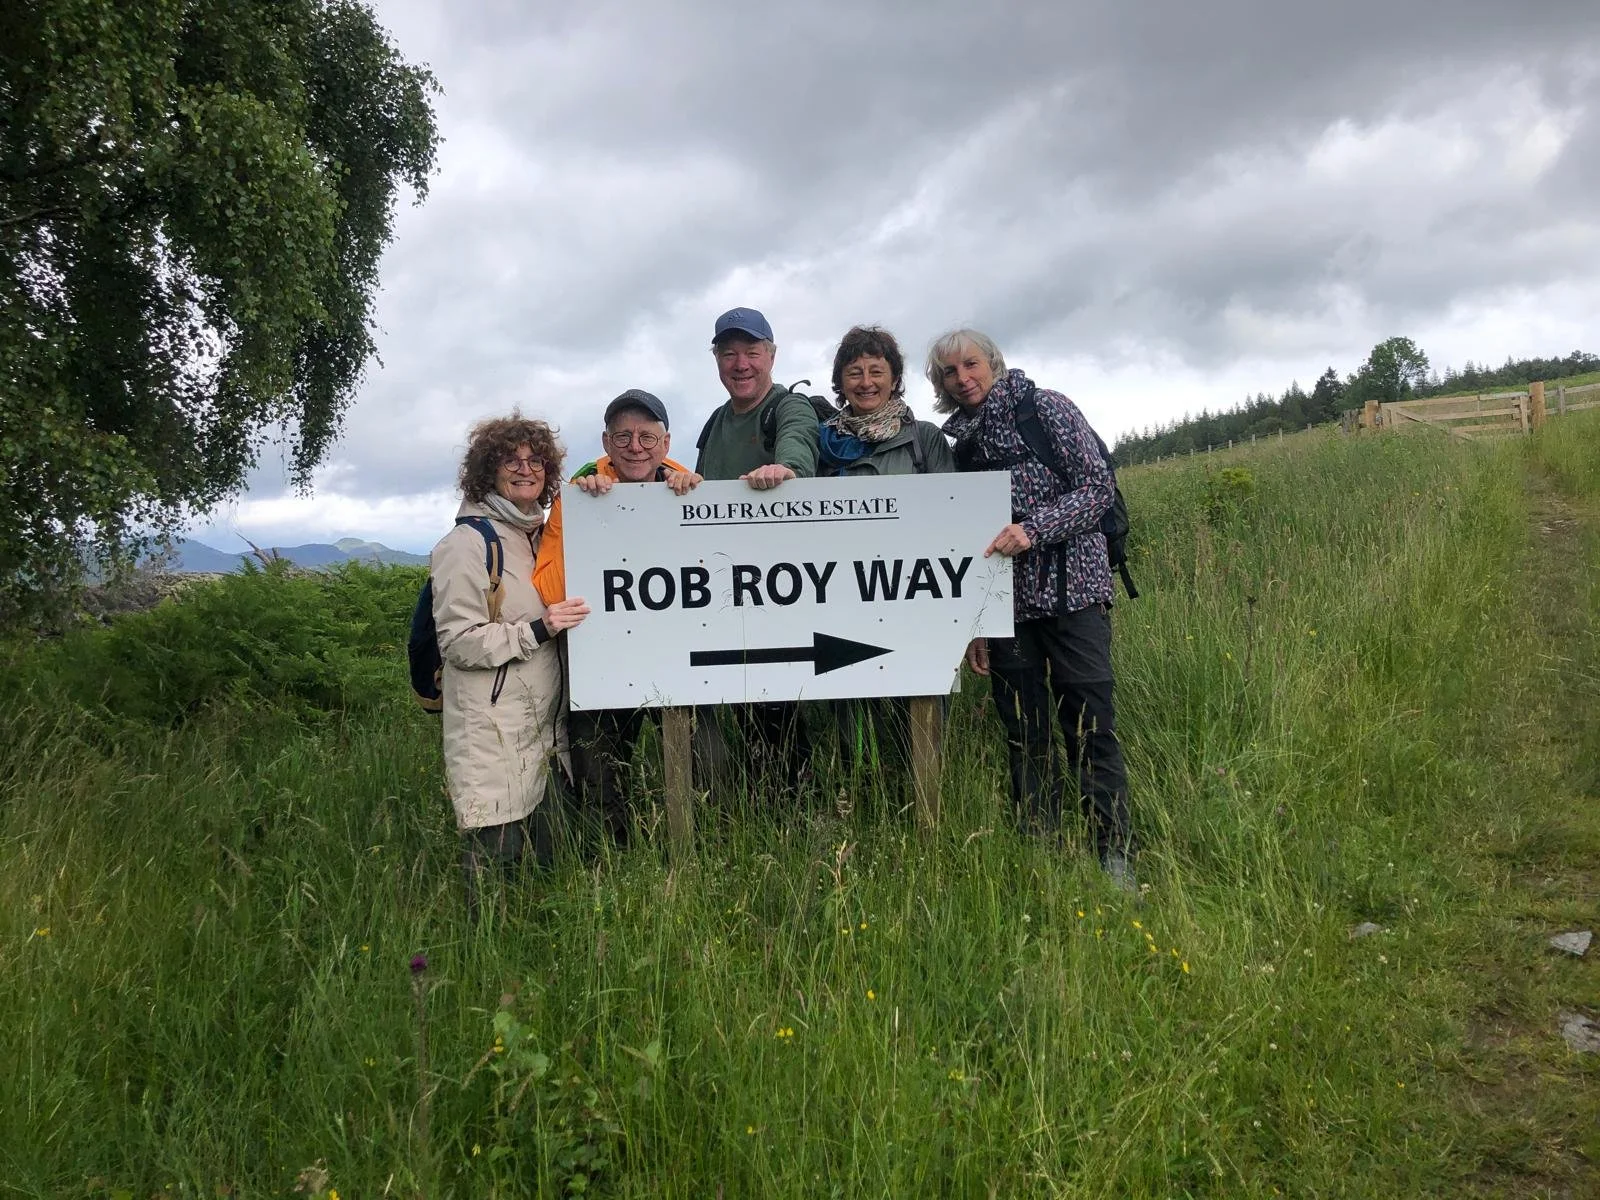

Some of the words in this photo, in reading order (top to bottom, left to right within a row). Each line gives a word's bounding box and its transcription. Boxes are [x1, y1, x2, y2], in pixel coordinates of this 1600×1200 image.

[681, 500, 813, 520] BOLFRACKS
[819, 497, 899, 517] ESTATE
[604, 567, 712, 613] ROB
[732, 562, 838, 607] ROY
[853, 556, 974, 602] WAY
